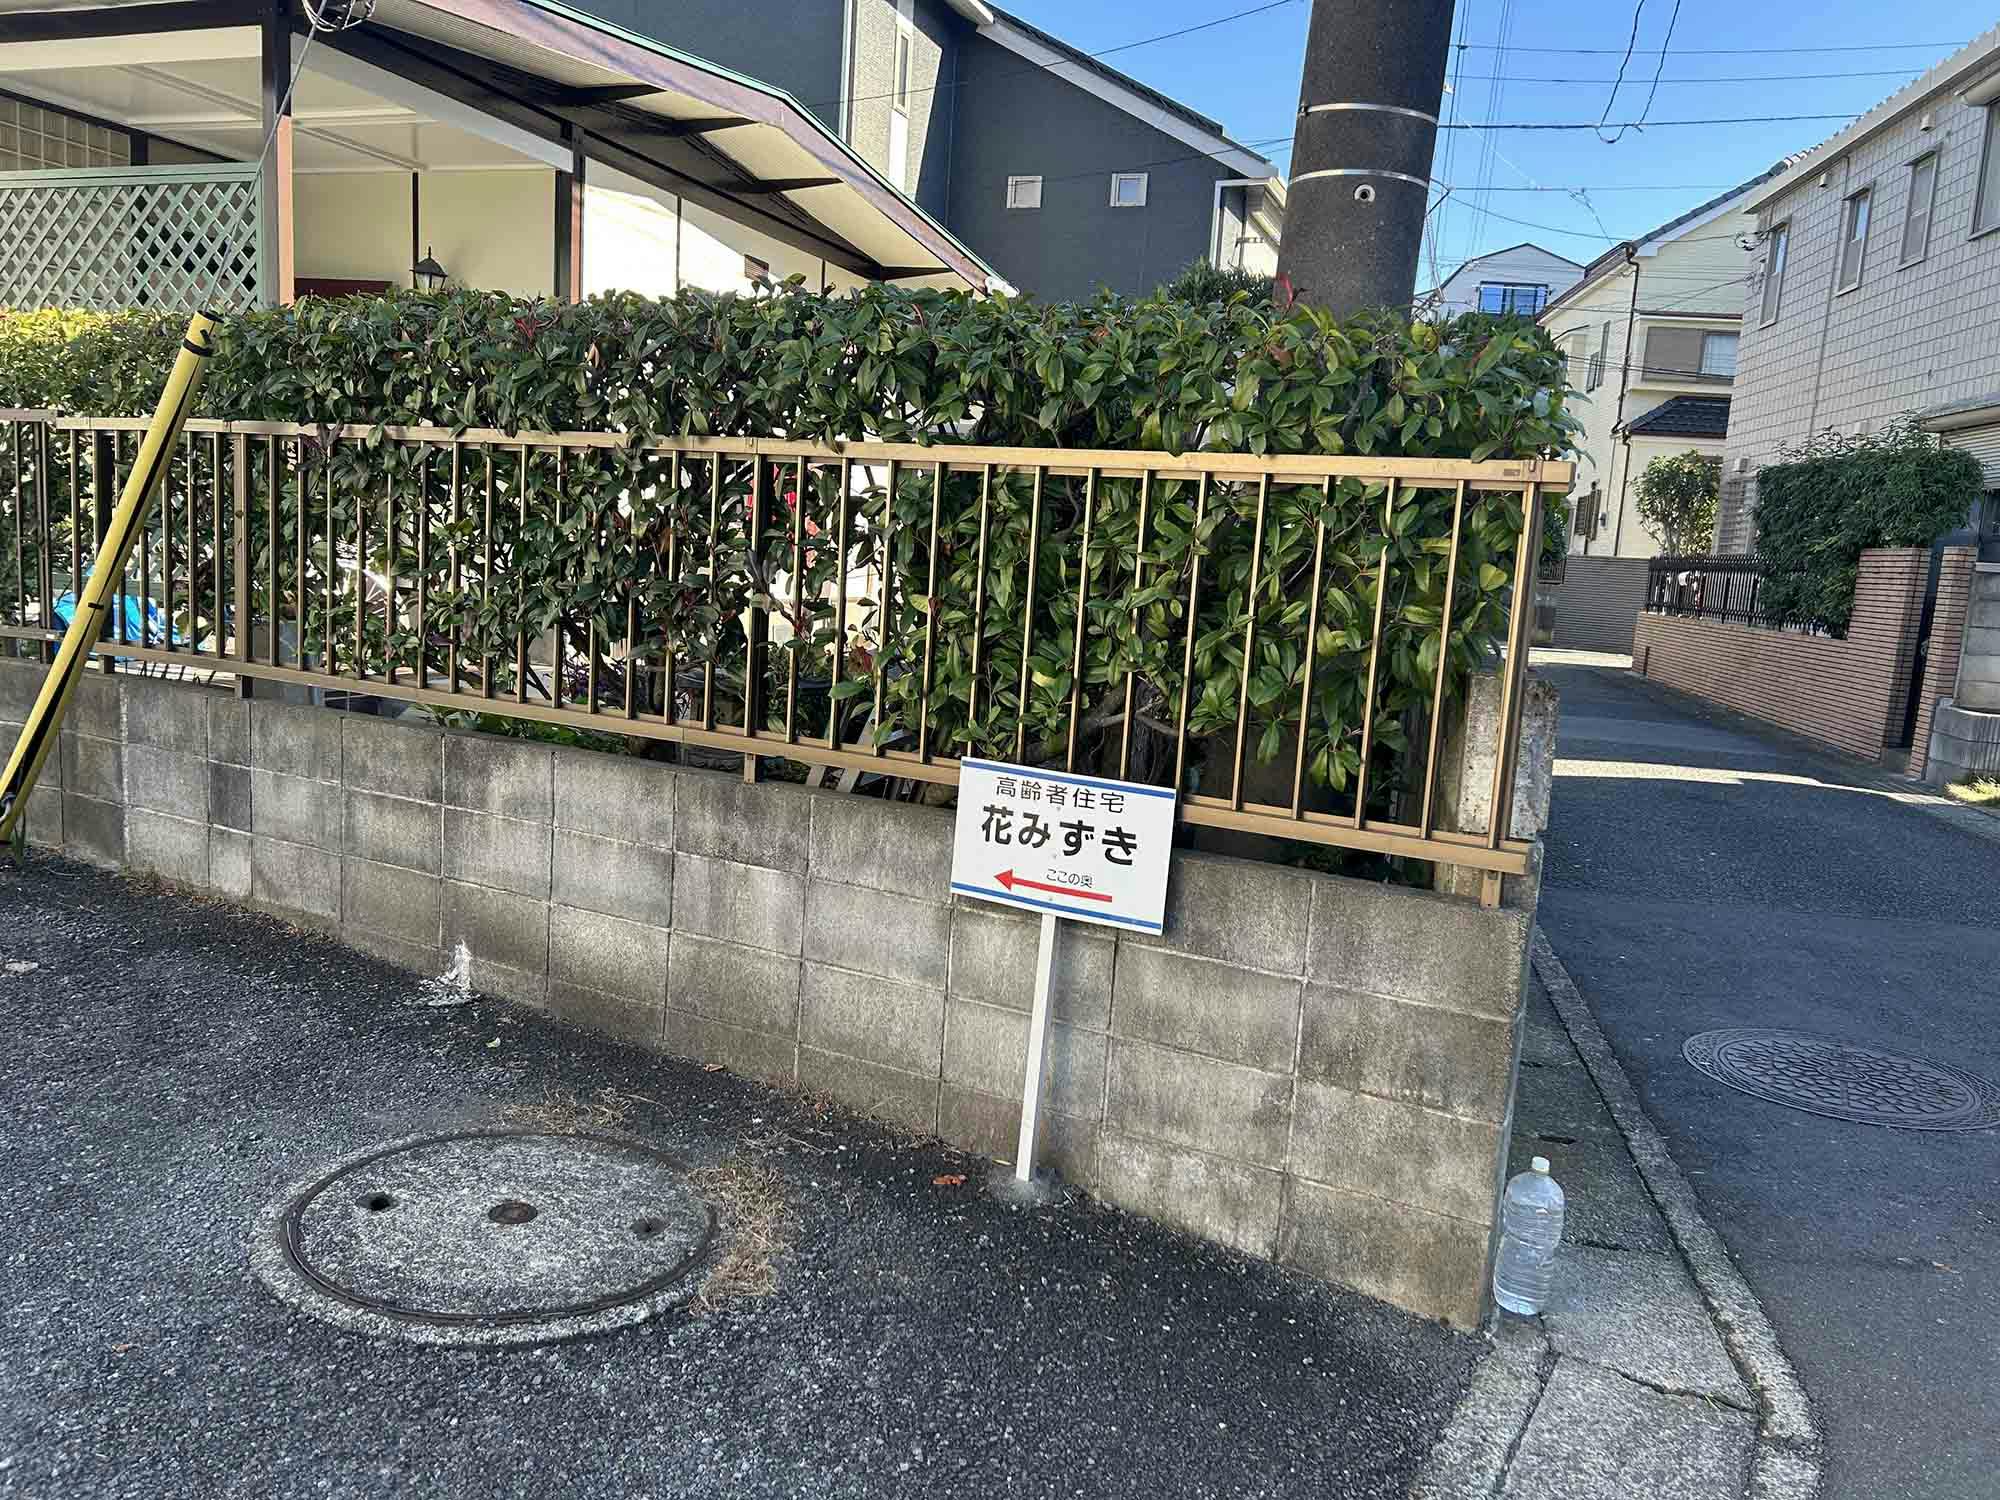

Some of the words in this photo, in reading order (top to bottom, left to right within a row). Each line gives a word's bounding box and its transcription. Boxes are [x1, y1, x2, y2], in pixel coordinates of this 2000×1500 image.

[996, 776, 1125, 814] 高齢者住宅
[981, 803, 1138, 867] 花みずき
[1046, 868, 1093, 889] ここの奥
